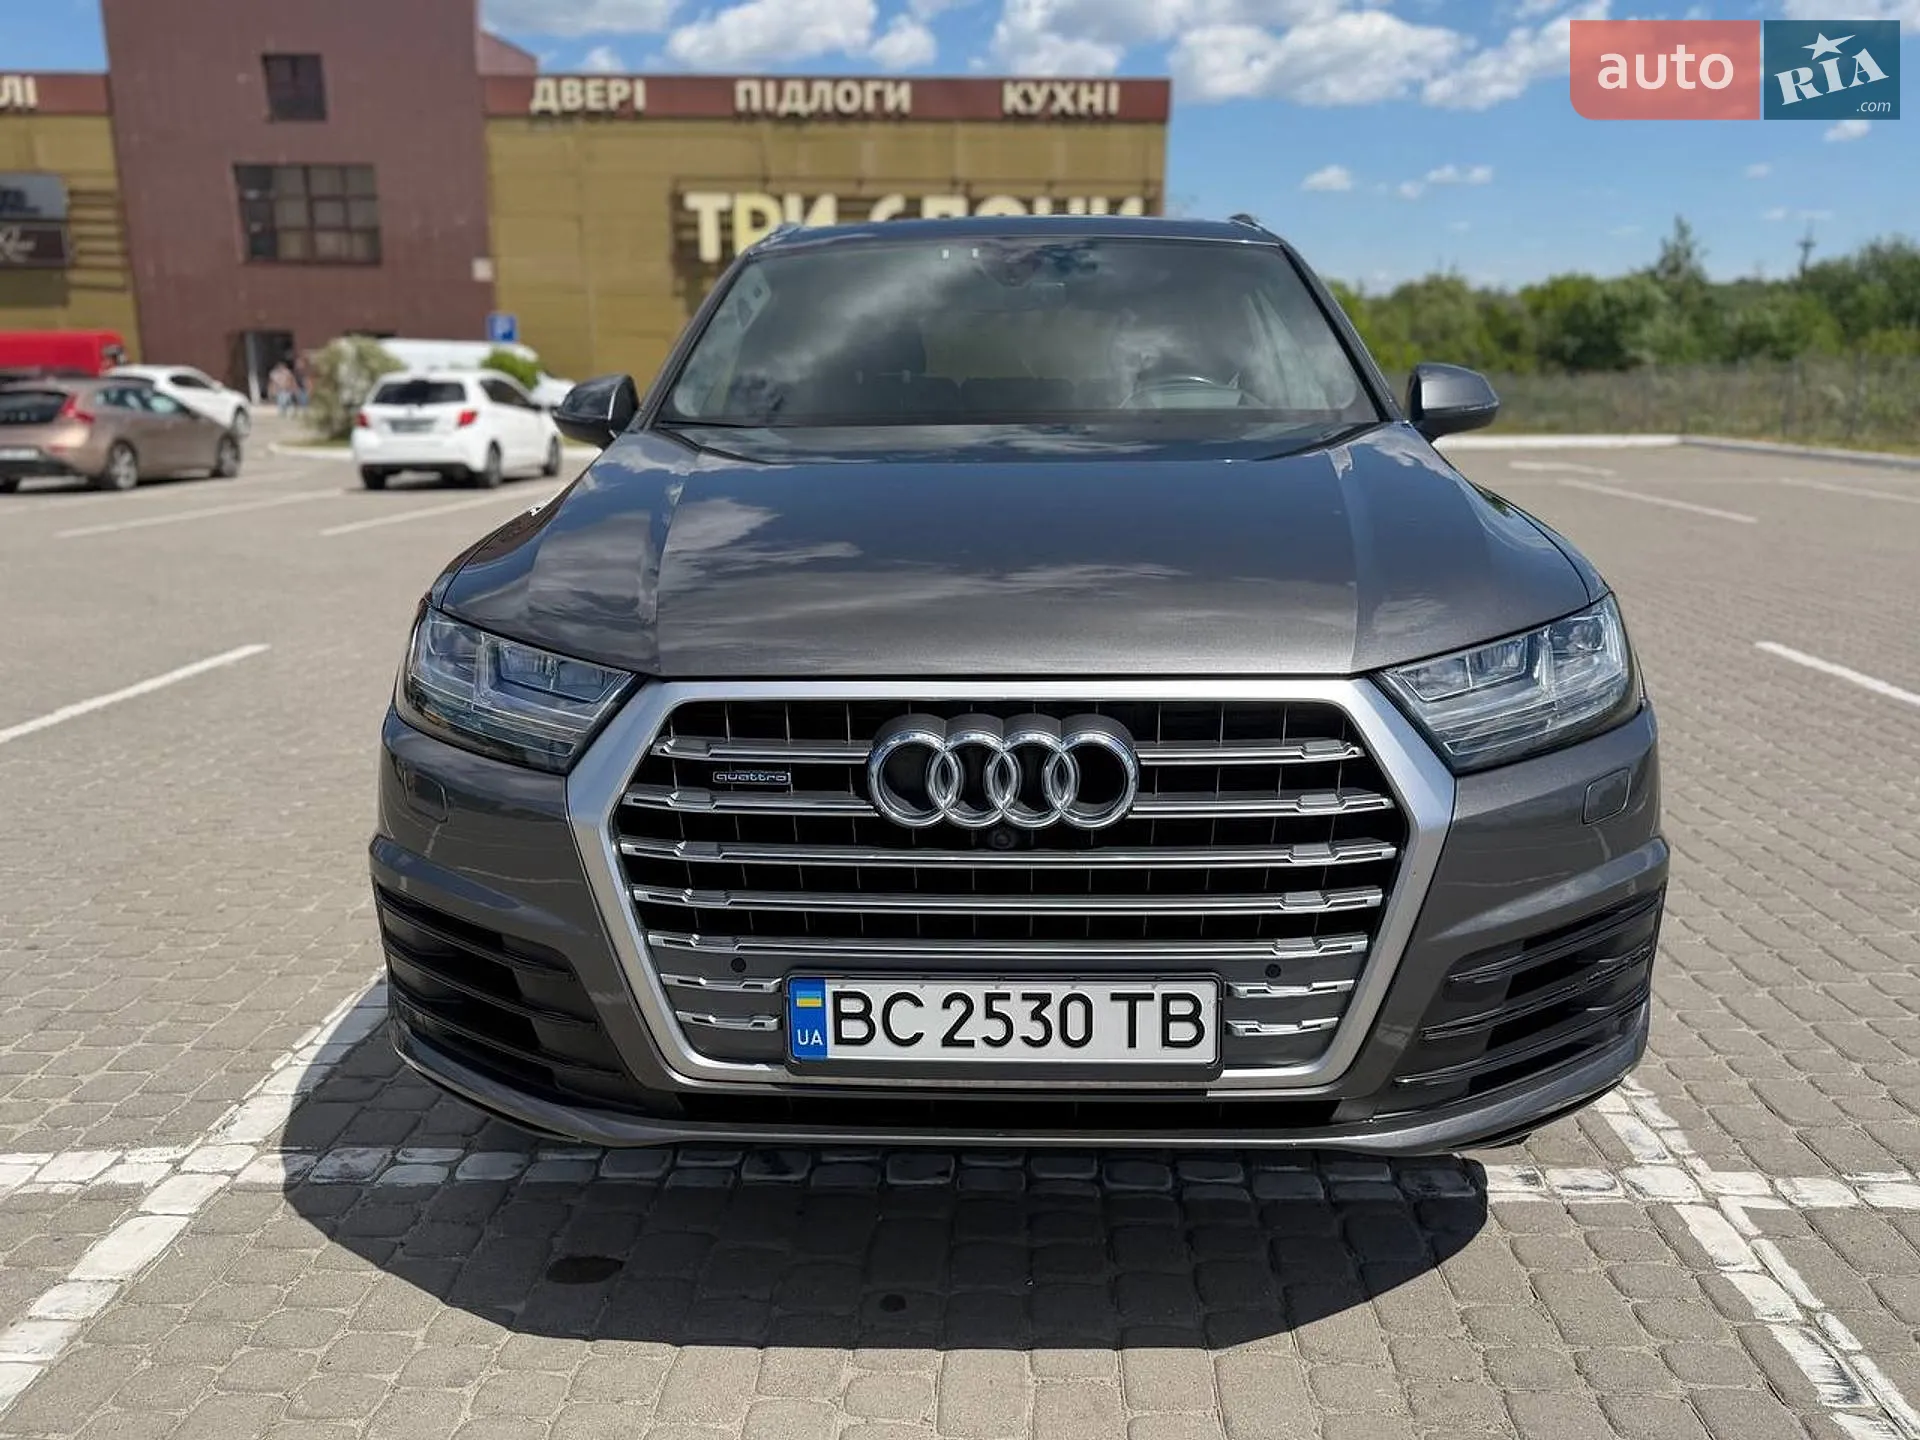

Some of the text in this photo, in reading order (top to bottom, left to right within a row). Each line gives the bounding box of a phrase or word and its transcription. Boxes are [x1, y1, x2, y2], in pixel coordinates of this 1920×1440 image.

[529, 77, 647, 116] ДВЕРІ
[734, 79, 913, 118] ПІДЛОГИ
[1002, 80, 1120, 116] КУХНІ
[716, 772, 788, 782] quattro
[831, 990, 1207, 1049] BC 2530 TB
[797, 1030, 824, 1047] UA
